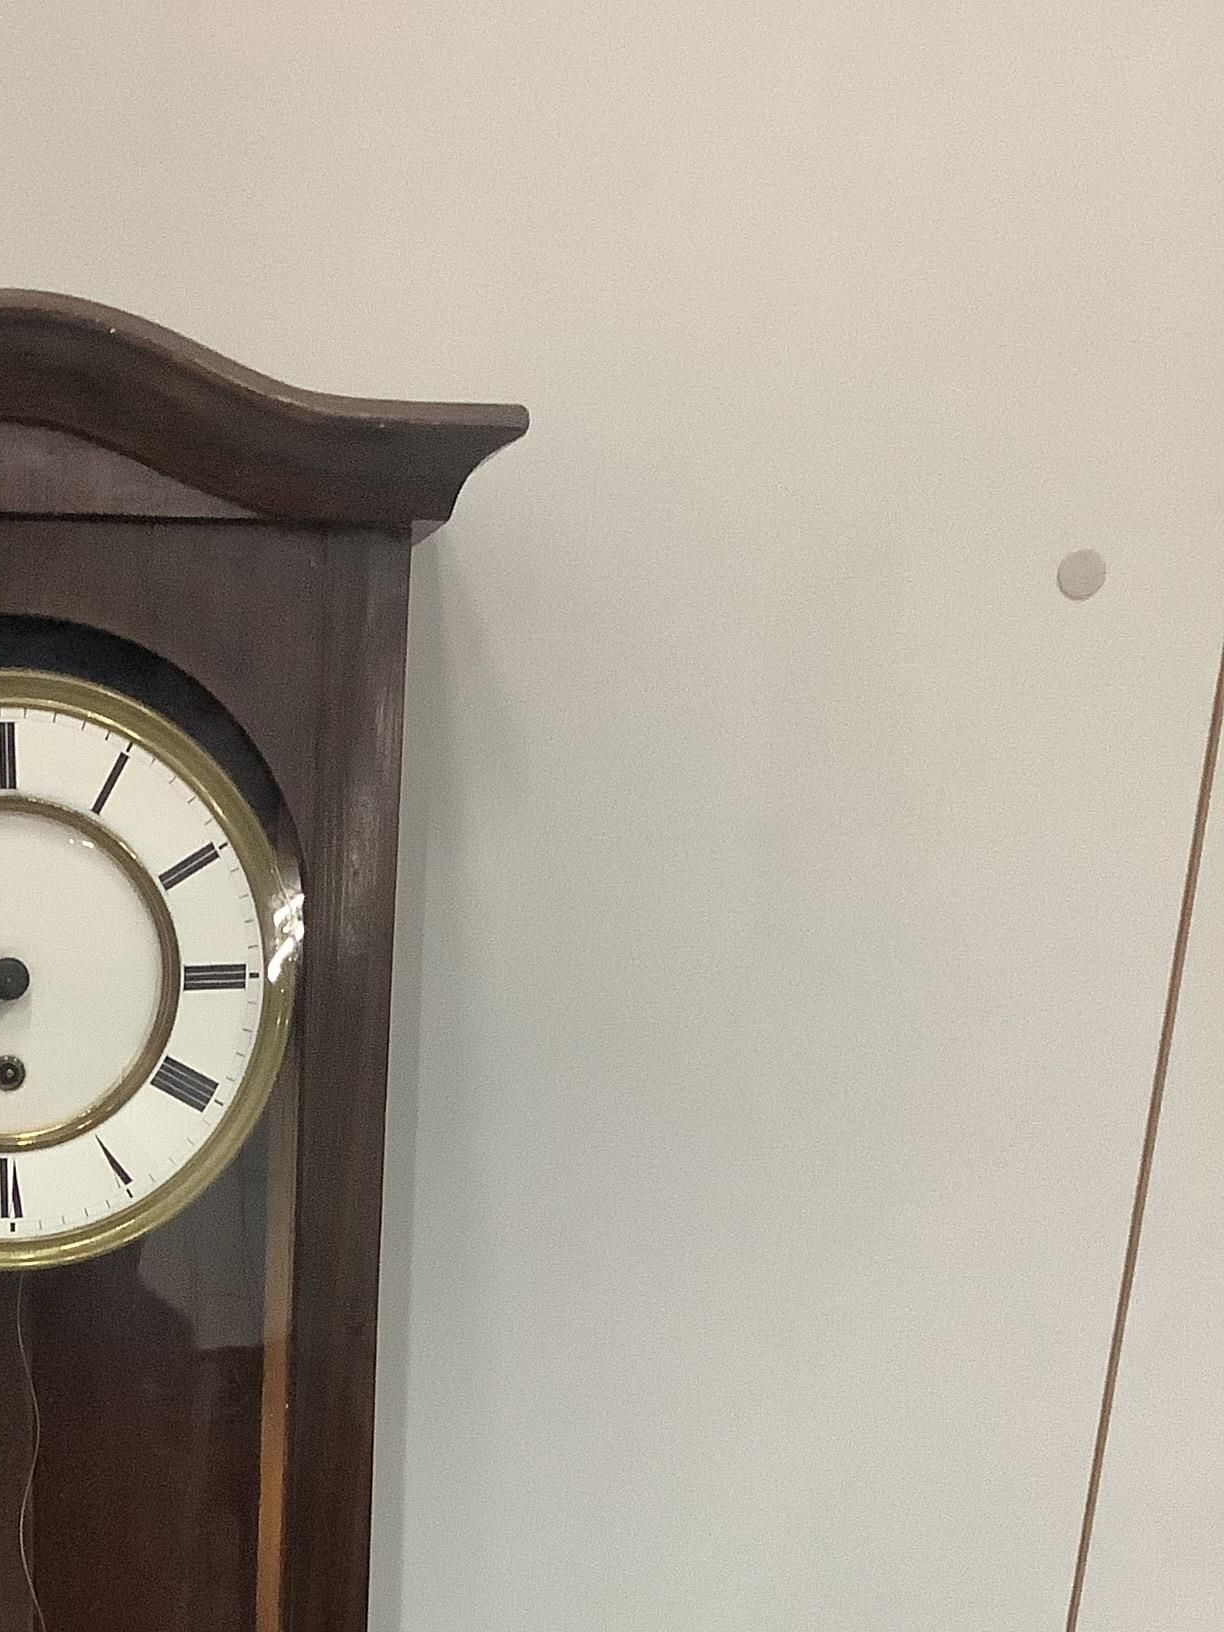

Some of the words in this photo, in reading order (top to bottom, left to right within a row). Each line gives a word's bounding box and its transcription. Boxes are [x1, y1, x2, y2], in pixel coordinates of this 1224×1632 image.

[158, 841, 220, 891] II
[183, 963, 246, 991] III
[150, 1055, 219, 1113] IIII
